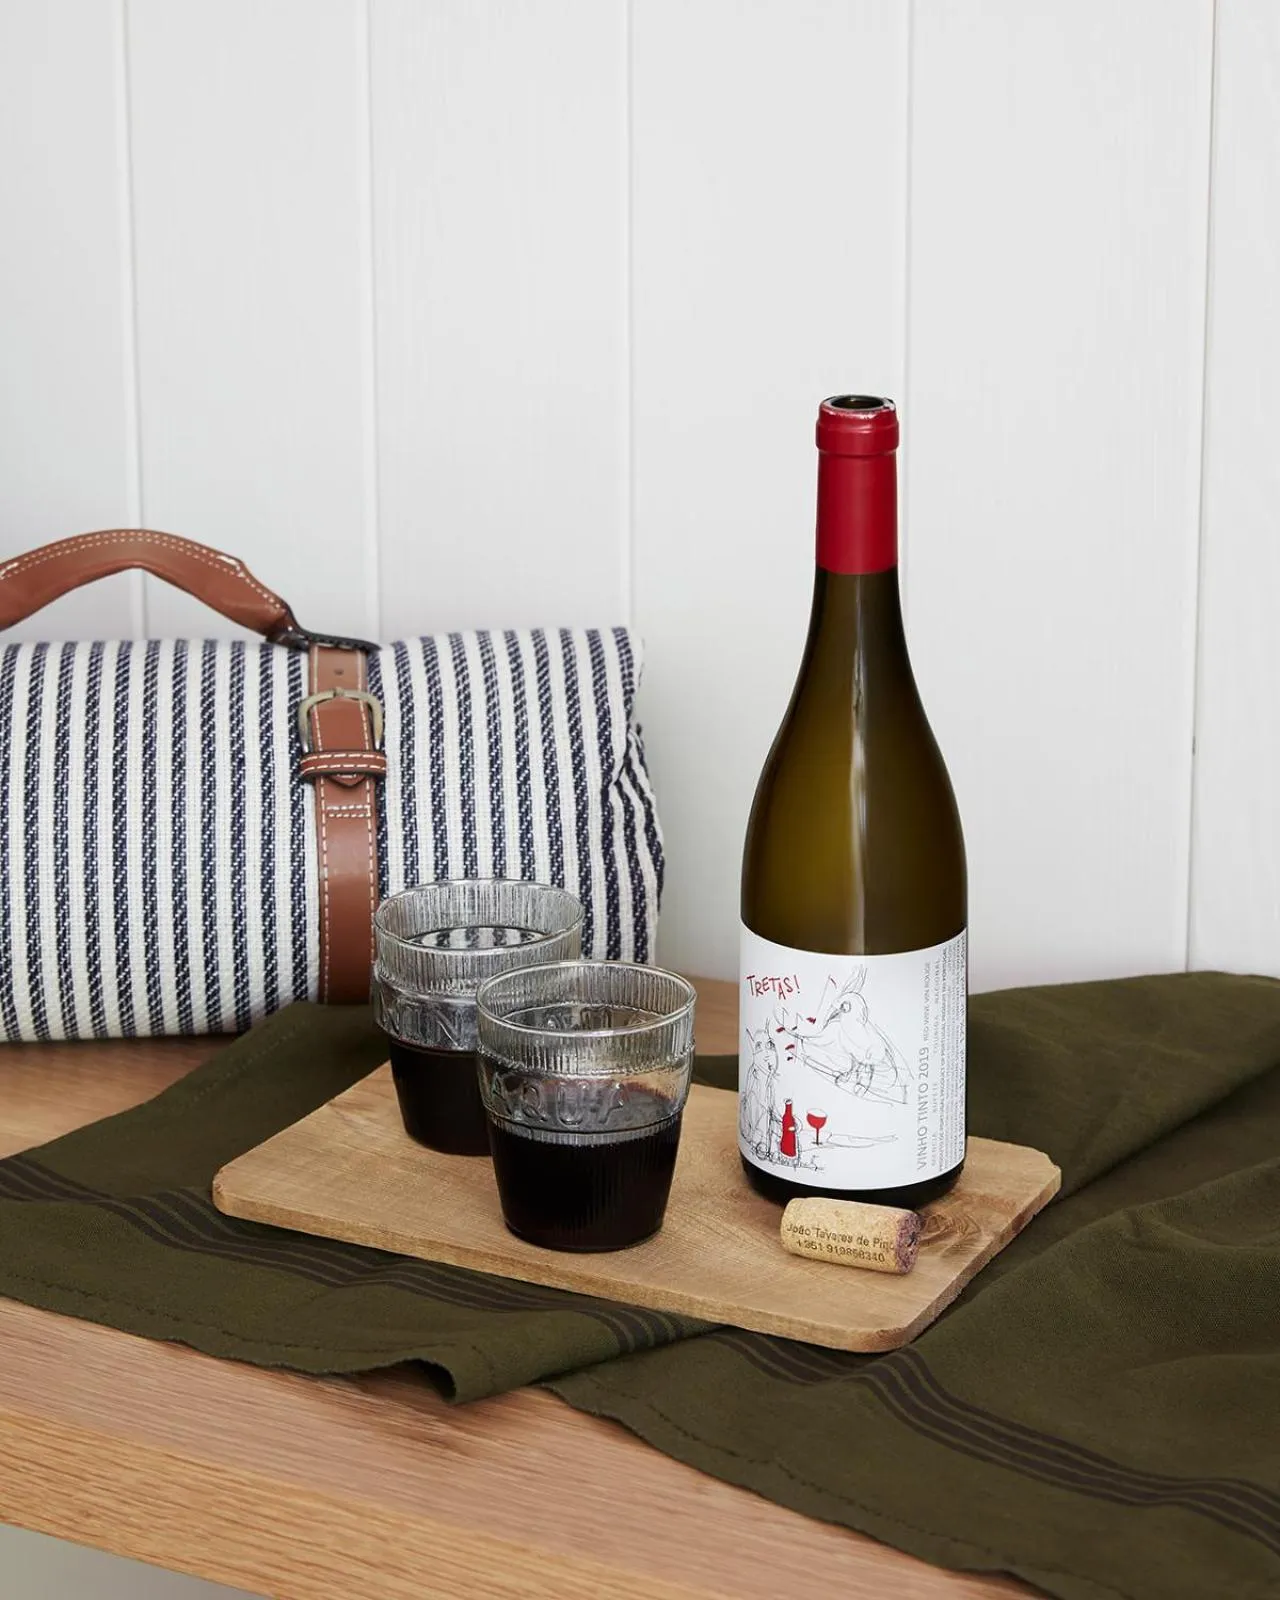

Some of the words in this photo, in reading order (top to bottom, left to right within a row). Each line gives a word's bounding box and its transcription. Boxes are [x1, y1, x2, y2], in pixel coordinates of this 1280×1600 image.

[747, 974, 800, 1000] TRETAS!
[918, 1047, 929, 1081] 2019
[917, 1083, 928, 1122] TINTO
[917, 1126, 928, 1170] VINHO
[786, 1223, 812, 1236] João
[815, 1227, 854, 1243] Tavares
[856, 1235, 870, 1247] de
